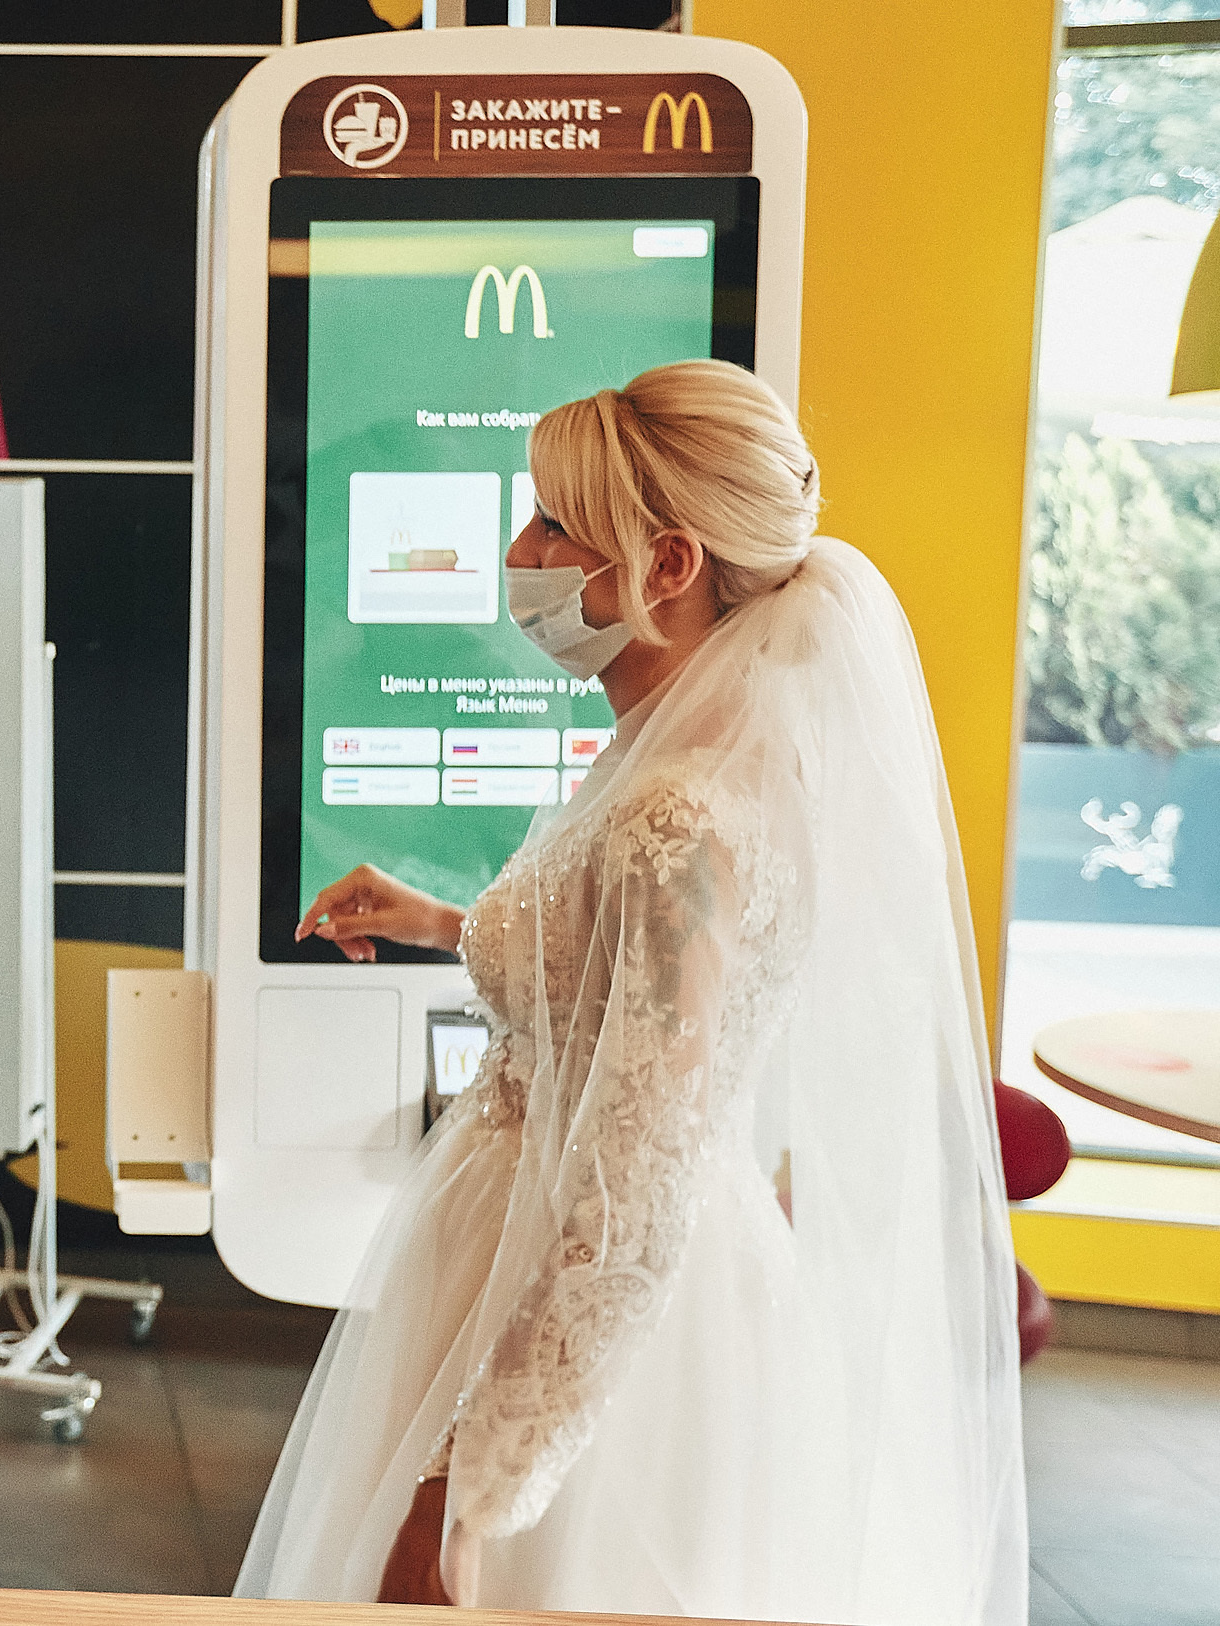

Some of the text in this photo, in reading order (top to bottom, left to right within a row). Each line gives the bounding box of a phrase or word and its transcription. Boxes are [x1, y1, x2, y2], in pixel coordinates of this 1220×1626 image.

[451, 123, 601, 151] ПРИНЕСЁМ
[417, 409, 447, 429] Как
[448, 412, 481, 429] вам
[380, 674, 426, 696] Цены
[427, 677, 439, 693] в
[440, 677, 487, 693] меню
[488, 677, 554, 697] указаны
[556, 677, 568, 693] в
[456, 696, 549, 714] Язык Меню
